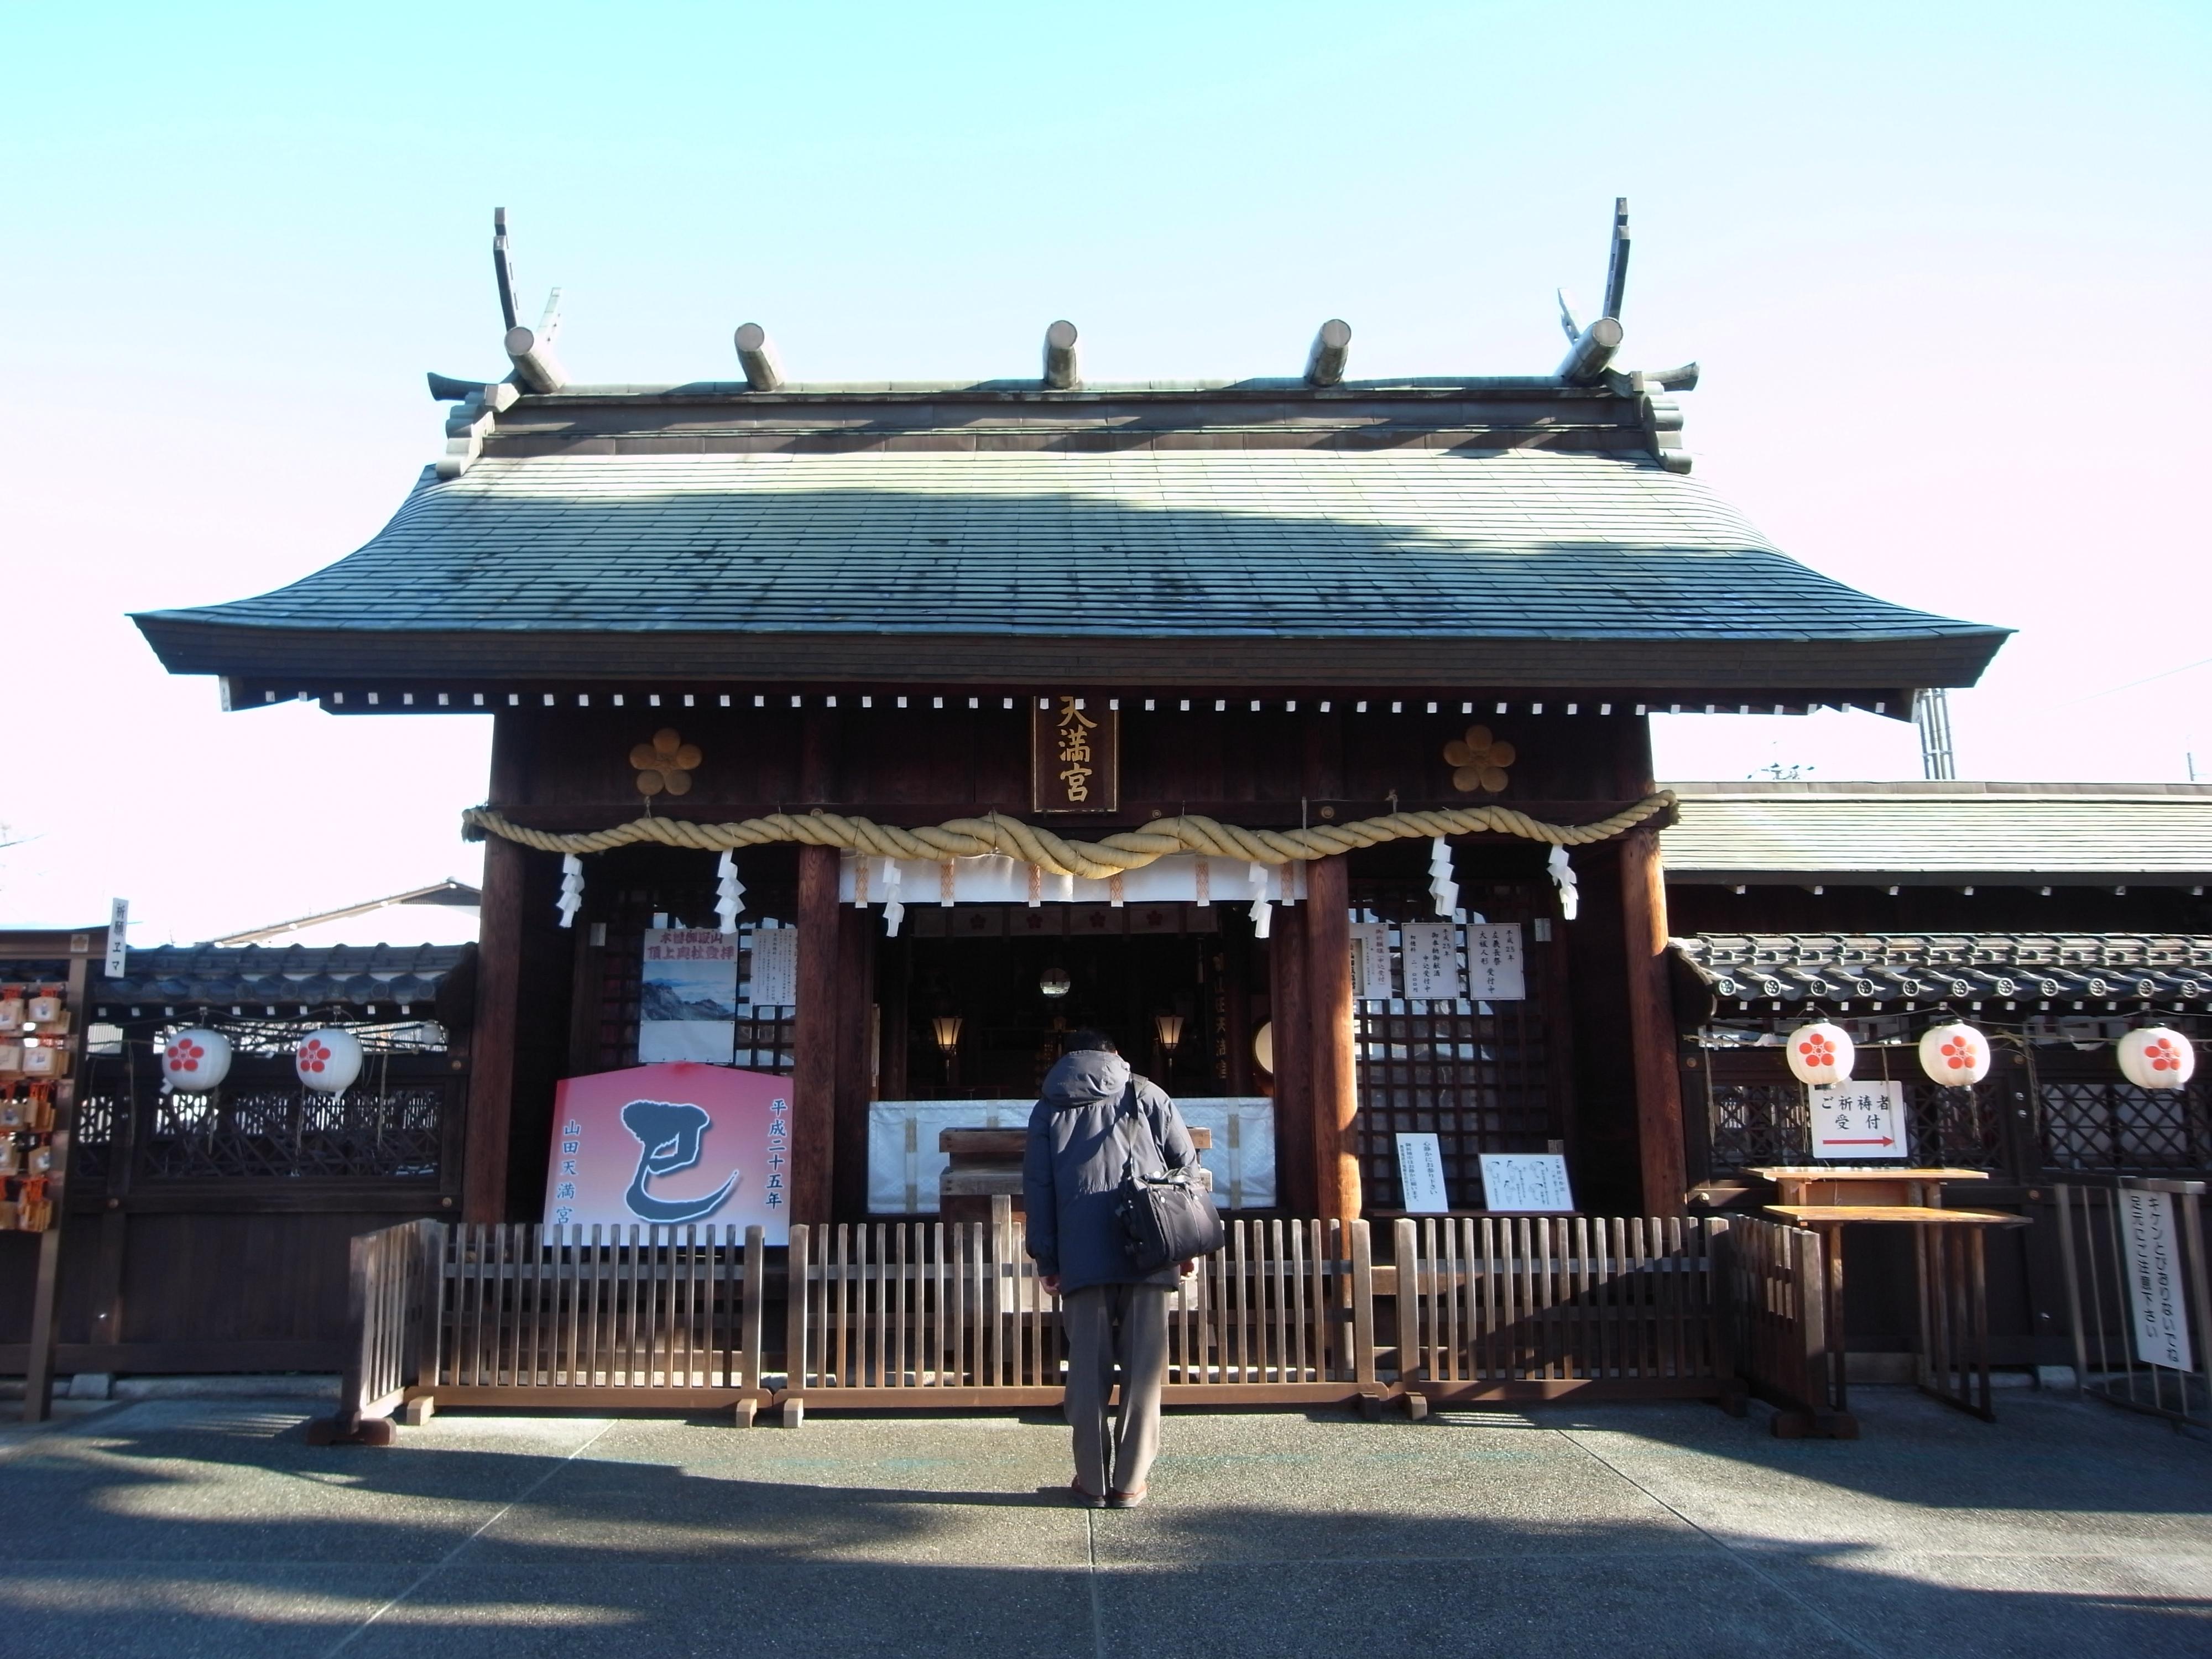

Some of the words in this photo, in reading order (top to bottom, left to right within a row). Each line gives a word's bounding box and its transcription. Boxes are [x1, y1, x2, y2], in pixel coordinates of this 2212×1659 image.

[1056, 696, 1098, 802] 天満宮
[1442, 928, 1451, 957] 平成25年
[1486, 968, 1495, 994] 受付中
[1506, 930, 1515, 962] 平成25年
[765, 1099, 787, 1209] 平成二十五年
[1822, 1095, 1890, 1111] ご祈祷者
[556, 1119, 581, 1224] 山田天満宮
[2131, 1195, 2158, 1338] 足元にご注意下さい
[2148, 1197, 2179, 1362] キケンとびおりないでね
